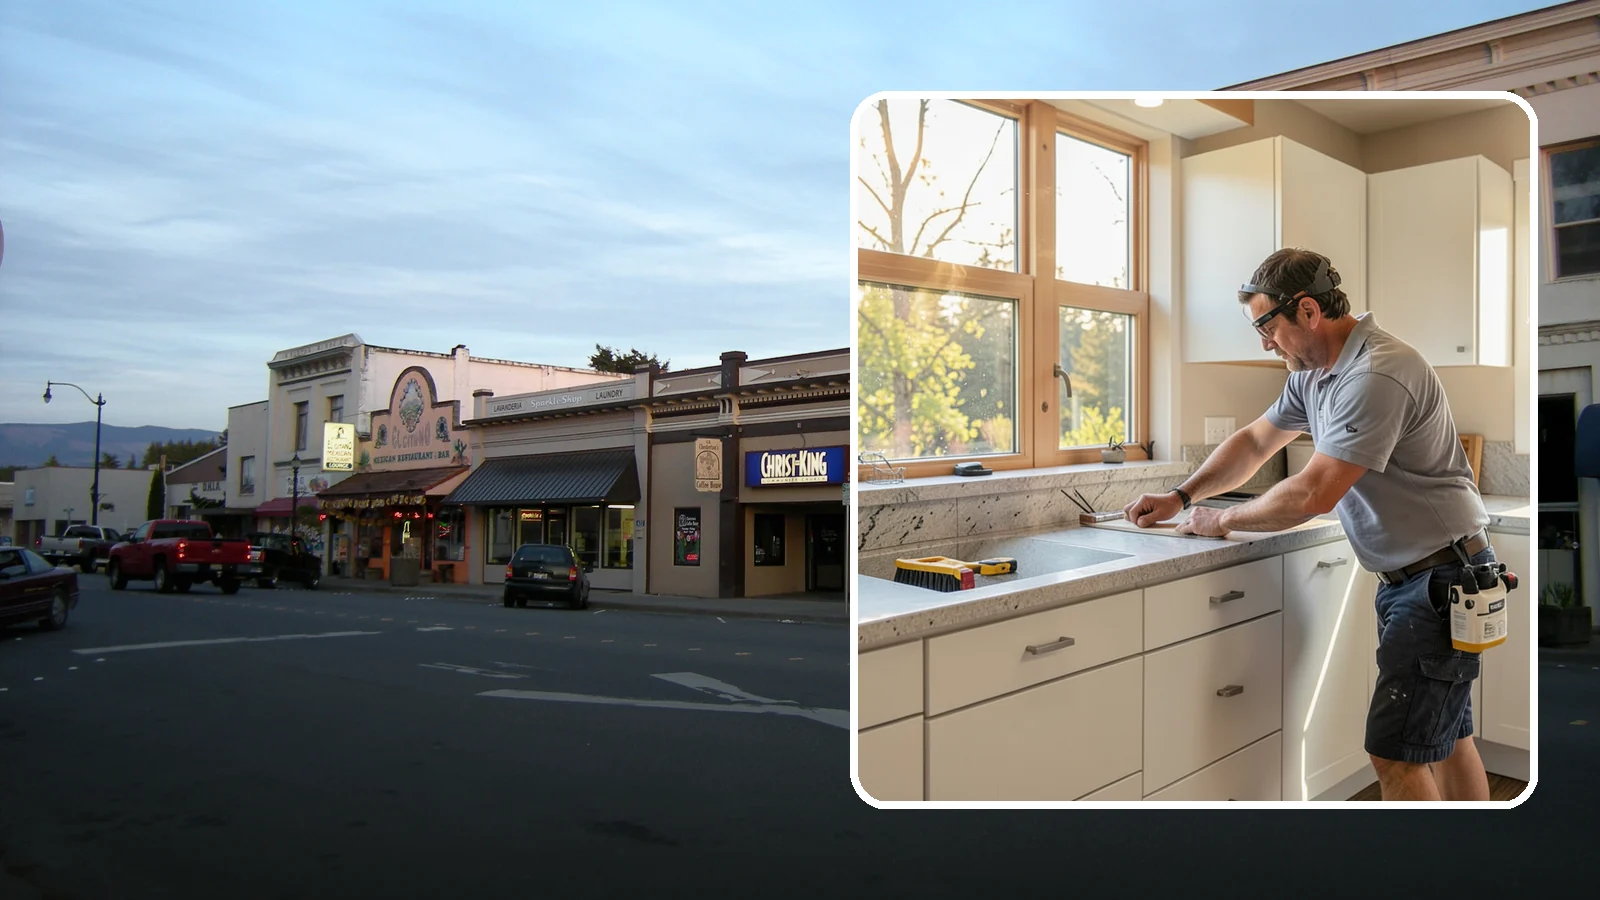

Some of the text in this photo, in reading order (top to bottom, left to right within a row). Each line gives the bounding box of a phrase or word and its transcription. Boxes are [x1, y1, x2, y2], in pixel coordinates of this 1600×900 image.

[595, 389, 624, 400] LAUNDRY
[493, 402, 523, 412] LAVANDERIA
[531, 394, 583, 410] Sparkle Shop
[373, 454, 396, 464] MEXICAN
[397, 451, 433, 462] RESTAURANT
[437, 450, 450, 459] BAR
[799, 450, 827, 476] KING
